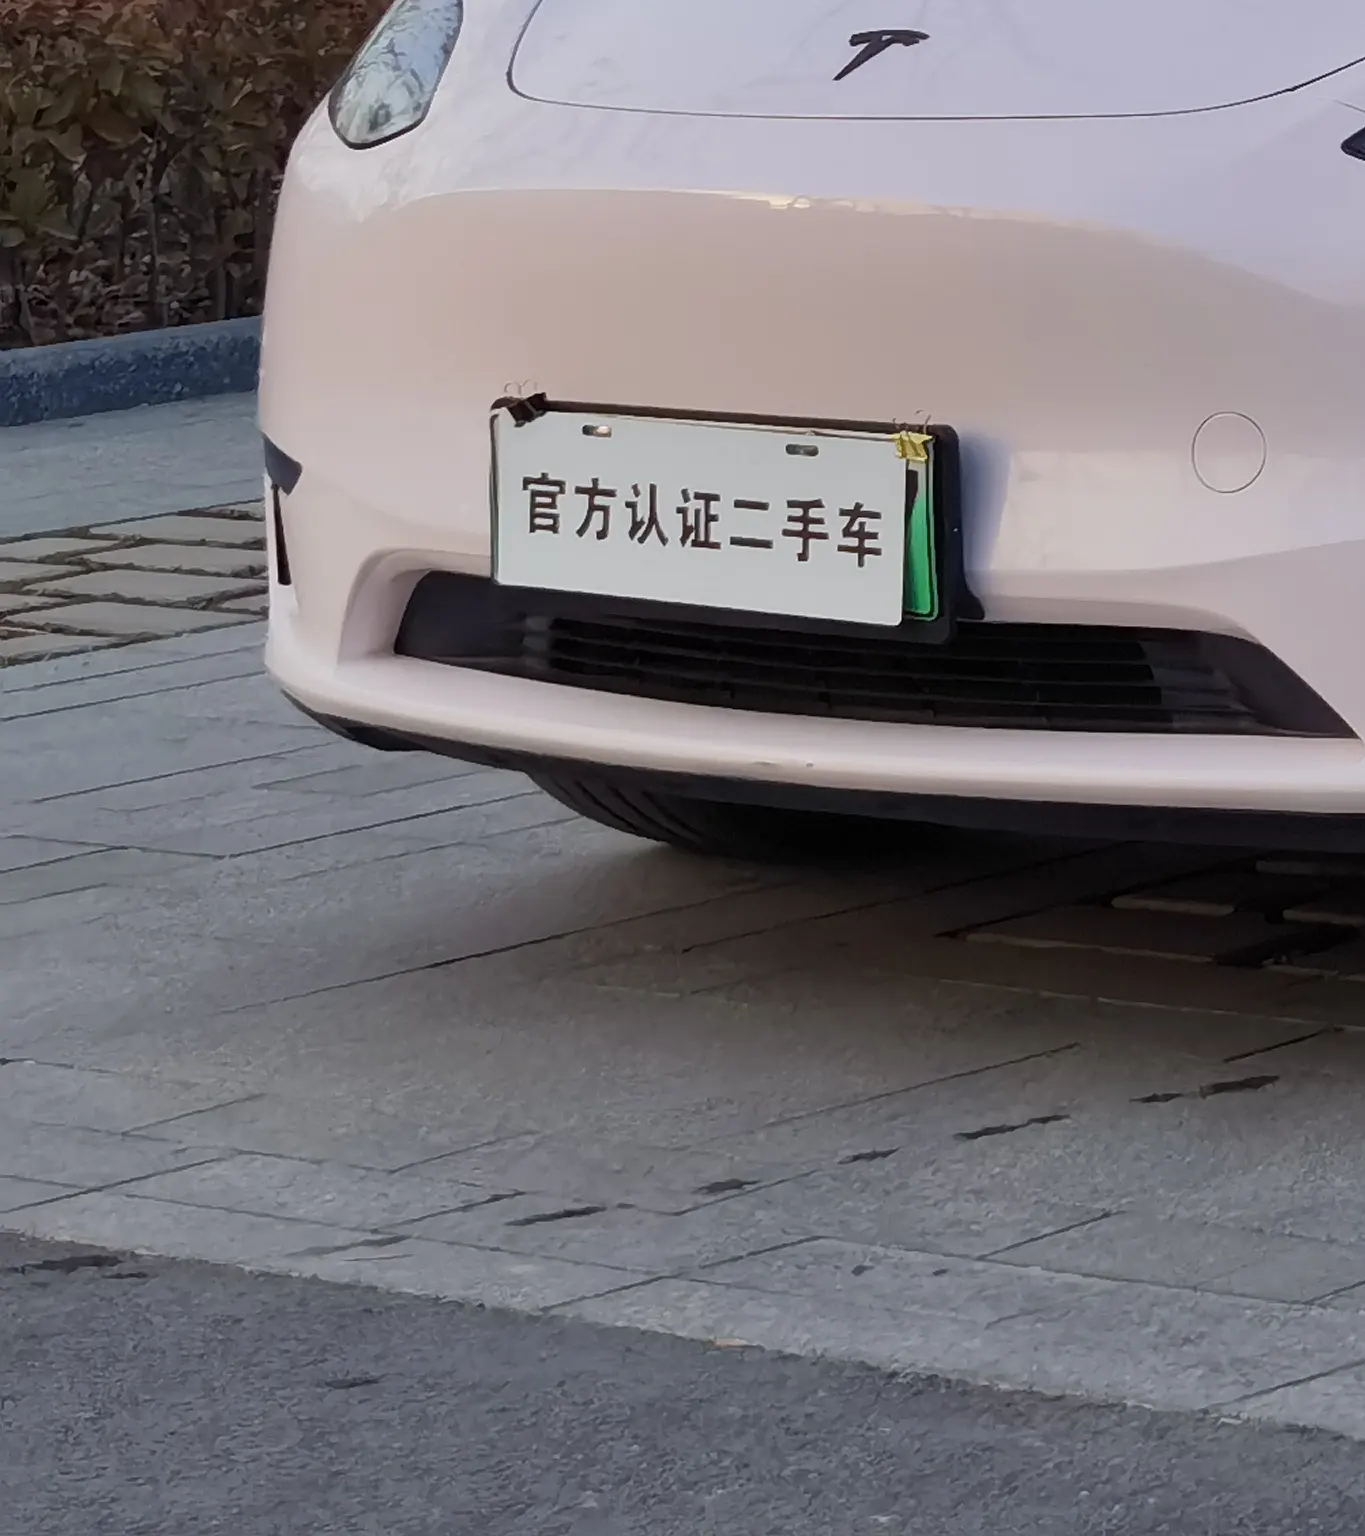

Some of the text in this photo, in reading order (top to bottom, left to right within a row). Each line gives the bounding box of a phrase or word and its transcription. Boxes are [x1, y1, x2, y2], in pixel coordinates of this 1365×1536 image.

[521, 471, 883, 567] 官方认证二手车
